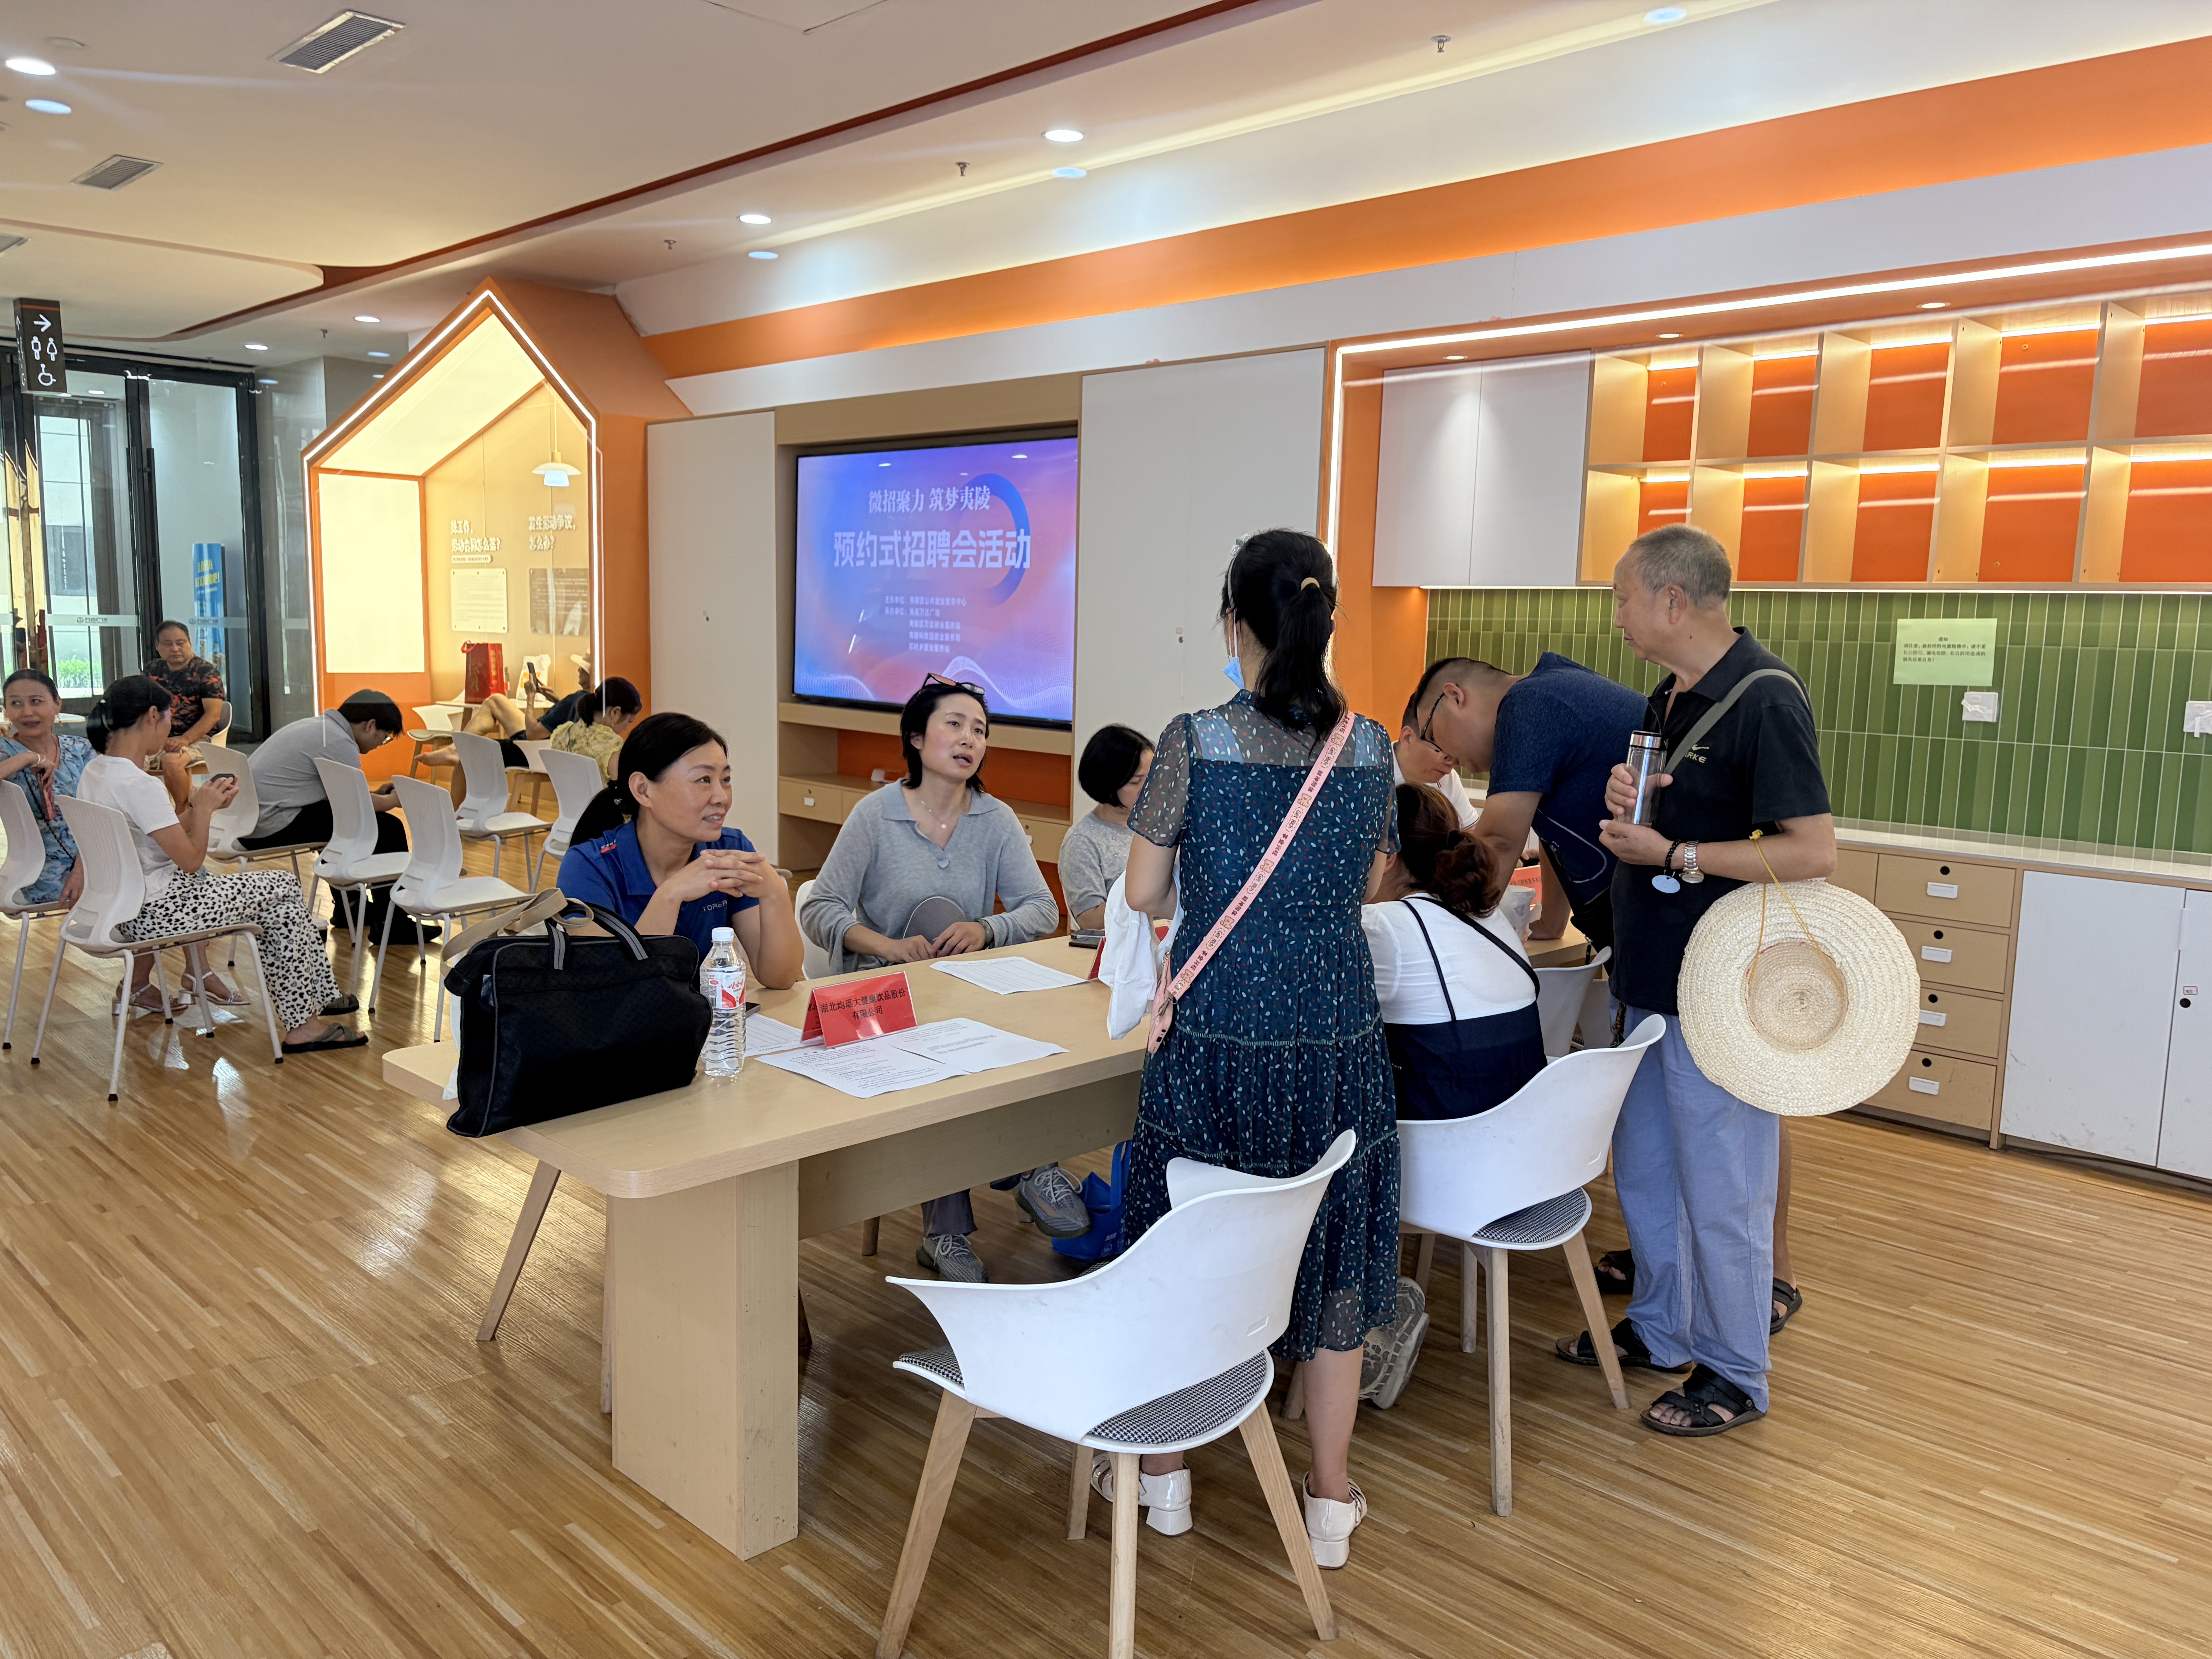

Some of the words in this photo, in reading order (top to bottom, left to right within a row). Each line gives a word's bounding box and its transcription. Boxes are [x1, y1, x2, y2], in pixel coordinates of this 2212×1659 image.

[869, 489, 924, 513] 微招聚力
[929, 485, 991, 512] 筑梦夷陵
[834, 529, 1031, 568] 预约式招聘会活动
[1322, 756, 1331, 765] Rich
[1249, 883, 1258, 891] Rich
[1215, 931, 1223, 939] Get
[1208, 939, 1217, 947] Rich
[820, 988, 905, 1013] 湖北均瑶大健康饮品股份
[852, 1005, 883, 1020] 有限公司
